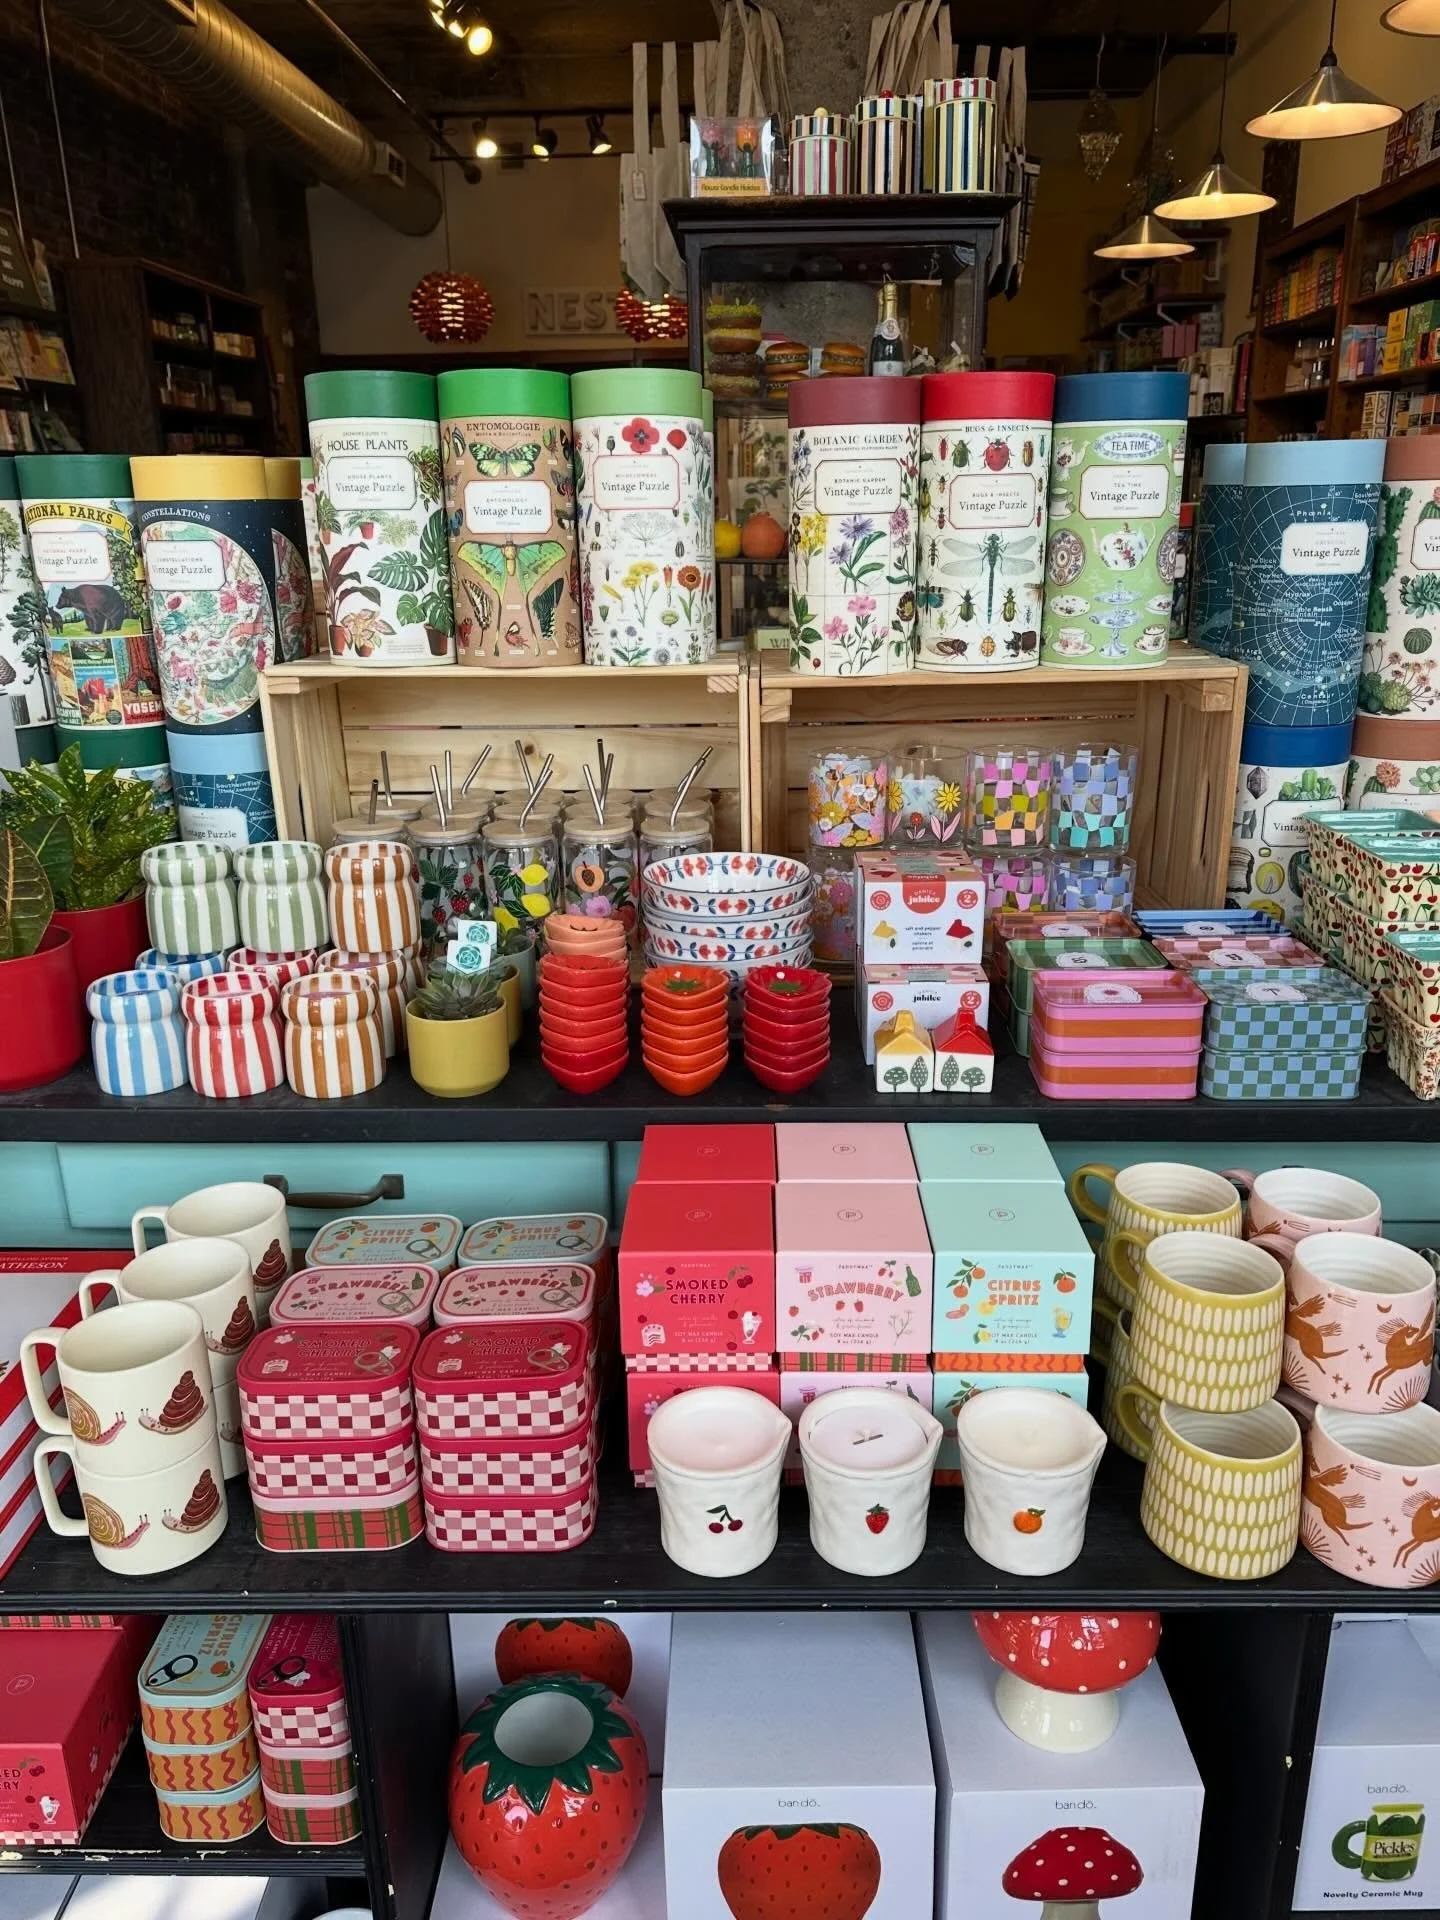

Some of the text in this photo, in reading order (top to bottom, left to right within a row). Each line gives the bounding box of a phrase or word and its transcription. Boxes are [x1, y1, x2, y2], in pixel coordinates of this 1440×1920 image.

[466, 422, 541, 432] ENTOMOLOGIE
[965, 425, 986, 433] BUGS
[997, 424, 1030, 433] INSECTS
[327, 440, 409, 451] HOUSE PLANTS
[813, 433, 905, 446] BOTANIC GARDEN
[1111, 440, 1151, 451] TEA TIME
[335, 481, 406, 494] Vintage Puzzle
[601, 481, 670, 494] Vintage Puzzle
[824, 484, 893, 498] Vintage Puzzle
[1090, 490, 1160, 503] Vintage Puzzle
[473, 505, 543, 518] Vintage Puzzle
[960, 499, 1028, 513] Vintage Puzzle
[25, 504, 113, 524] ATIONAL PARKS
[142, 507, 211, 522] CONSTELLATIONS
[1292, 546, 1360, 560] Vintage Puzzle
[66, 556, 98, 565] Puzzle
[180, 565, 213, 574] Puzzle
[1273, 822, 1305, 834] Vintag
[208, 830, 237, 839] Puzzle
[908, 894, 972, 905] jubilee 2
[913, 994, 941, 1003] jubilee
[363, 1228, 415, 1238] CITRUS
[360, 1236, 410, 1245] SPRITZ
[307, 1279, 410, 1295] STRAWBERRY
[467, 1277, 569, 1293] STRAWBERRY
[666, 1279, 729, 1291] SMOKED
[987, 1279, 1041, 1292] CITRUS
[807, 1281, 905, 1302] STRAWBERRY
[670, 1293, 725, 1305] CHERRY
[989, 1294, 1039, 1306] SPRITZ
[471, 1336, 541, 1347] SMOKED
[197, 1615, 228, 1656] SPRITZ
[212, 1615, 243, 1657] CITRUS
[0, 1769, 21, 1778] ED
[1373, 1840, 1415, 1855] Pickles
[1361, 1890, 1400, 1898] Ceramic
[1403, 1889, 1424, 1899] Mug
